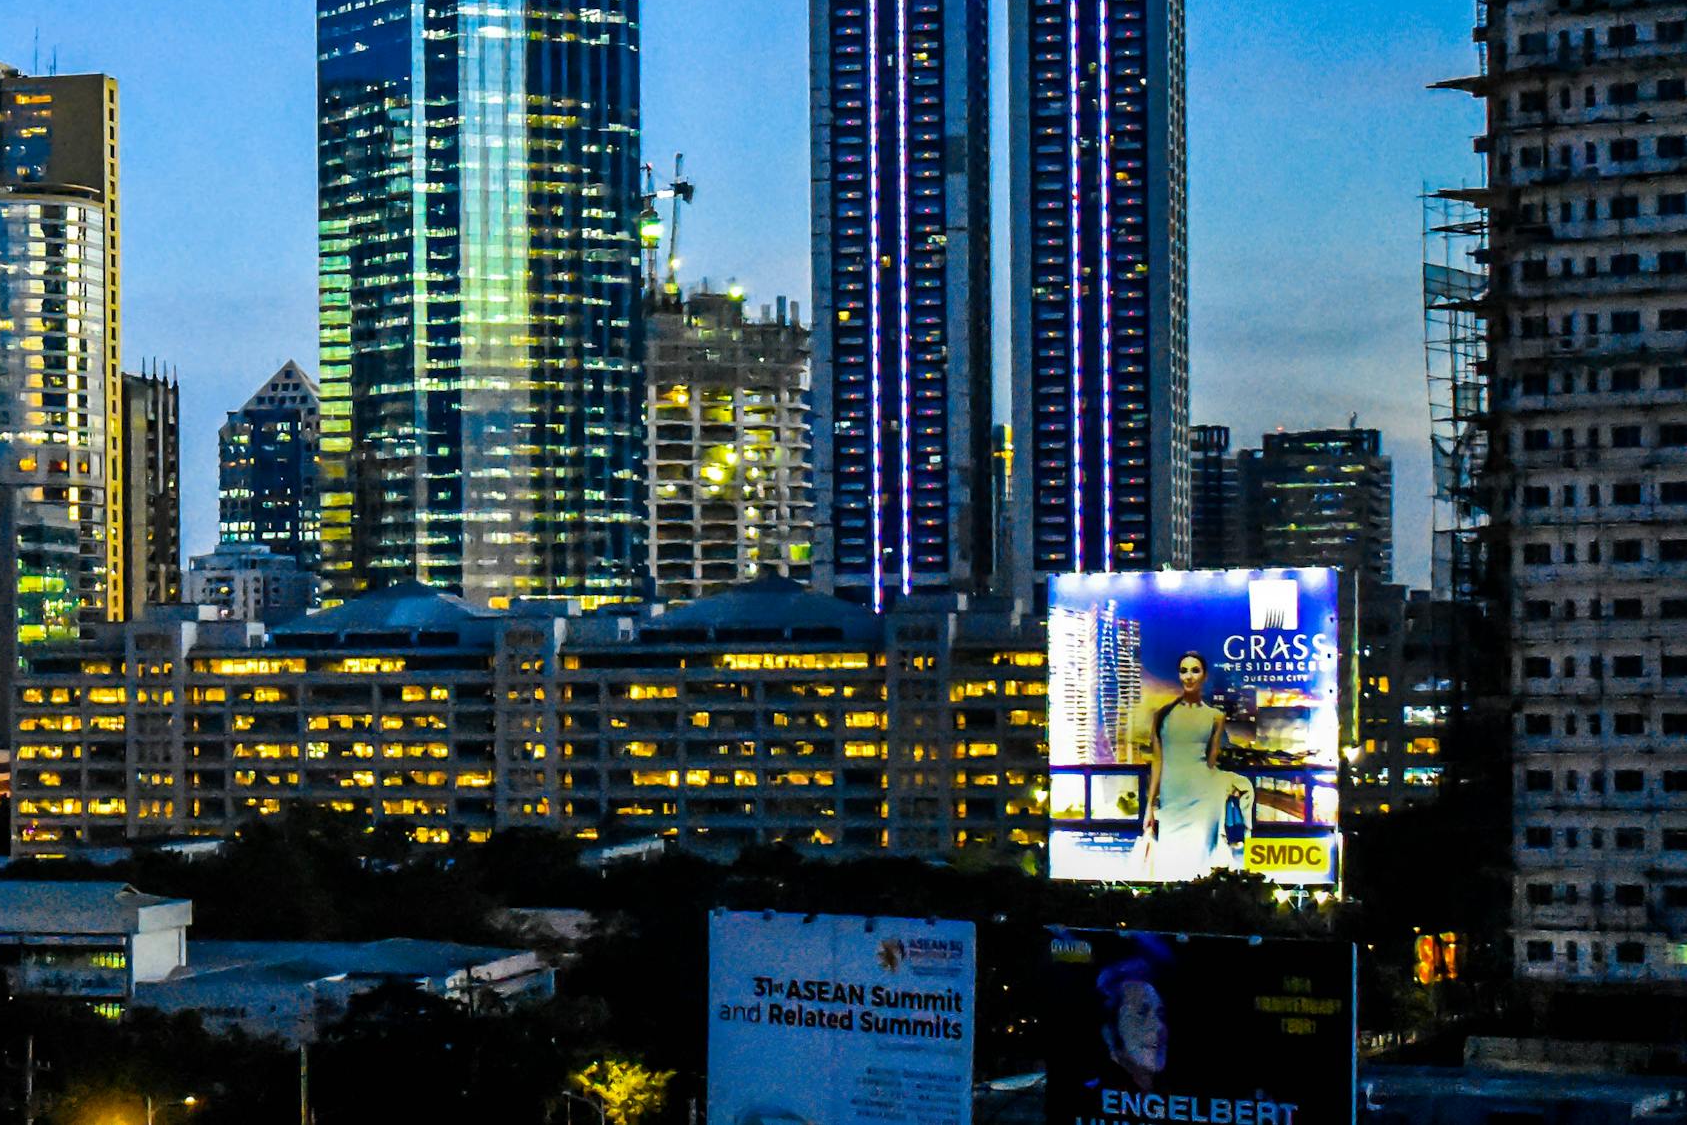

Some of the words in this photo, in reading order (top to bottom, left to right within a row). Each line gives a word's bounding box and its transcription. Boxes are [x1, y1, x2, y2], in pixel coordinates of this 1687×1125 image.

[1223, 633, 1329, 661] GRASS
[1286, 674, 1308, 682] CITY
[1250, 843, 1322, 866] SMDC
[786, 979, 865, 1006] ASEAN
[871, 986, 963, 1013] Summit
[719, 1003, 761, 1022] and
[769, 1003, 854, 1031] Related
[859, 1011, 963, 1040] Summits
[1101, 1088, 1299, 1125] ENGELBERT
